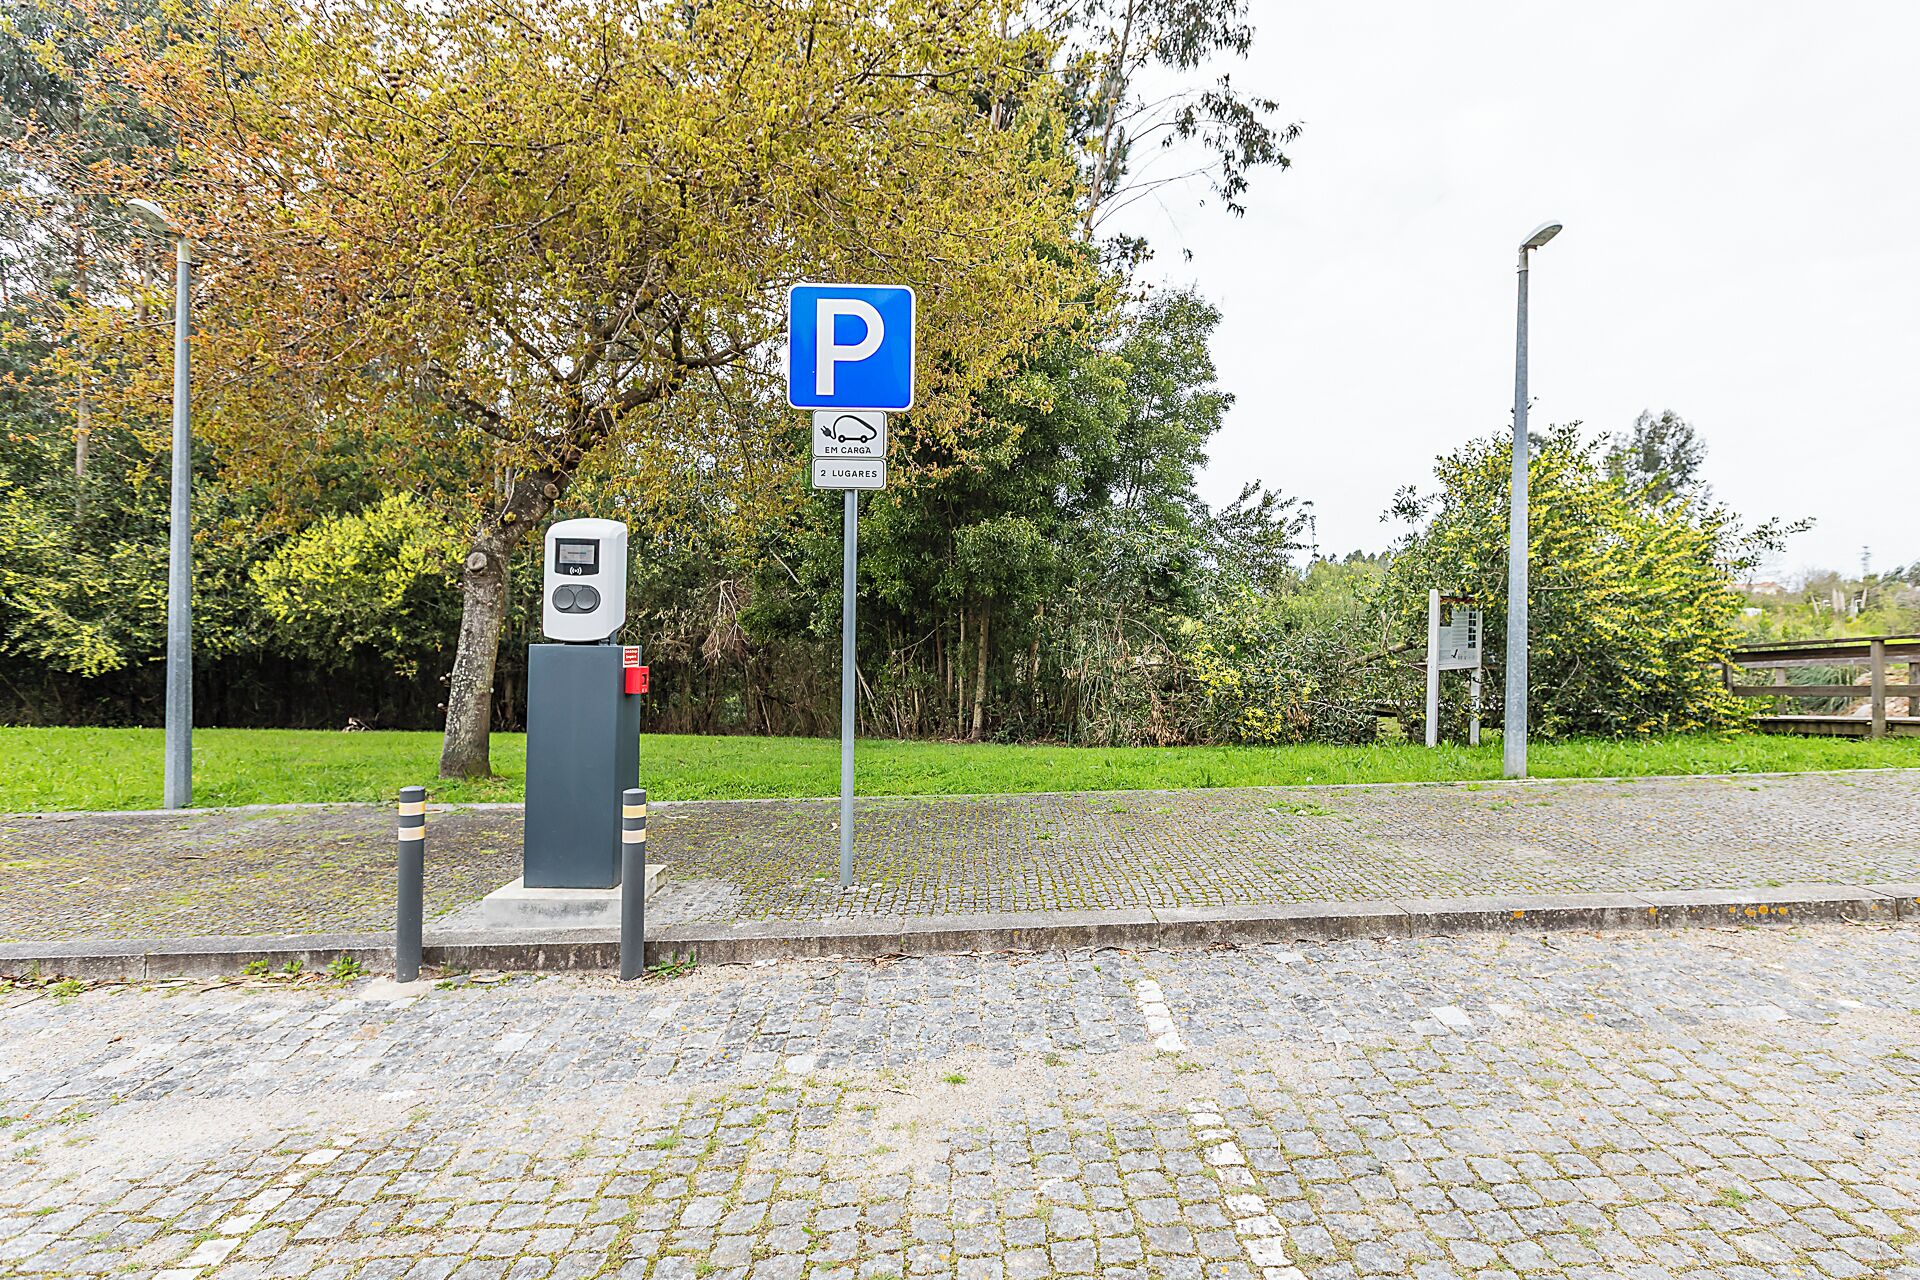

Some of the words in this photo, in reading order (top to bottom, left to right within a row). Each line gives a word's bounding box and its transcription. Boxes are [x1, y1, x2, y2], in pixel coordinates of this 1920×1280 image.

[816, 298, 885, 396] P
[824, 446, 838, 454] EM
[840, 446, 872, 454] CARGA
[820, 469, 826, 477] 2
[832, 470, 878, 478] LUGARES
